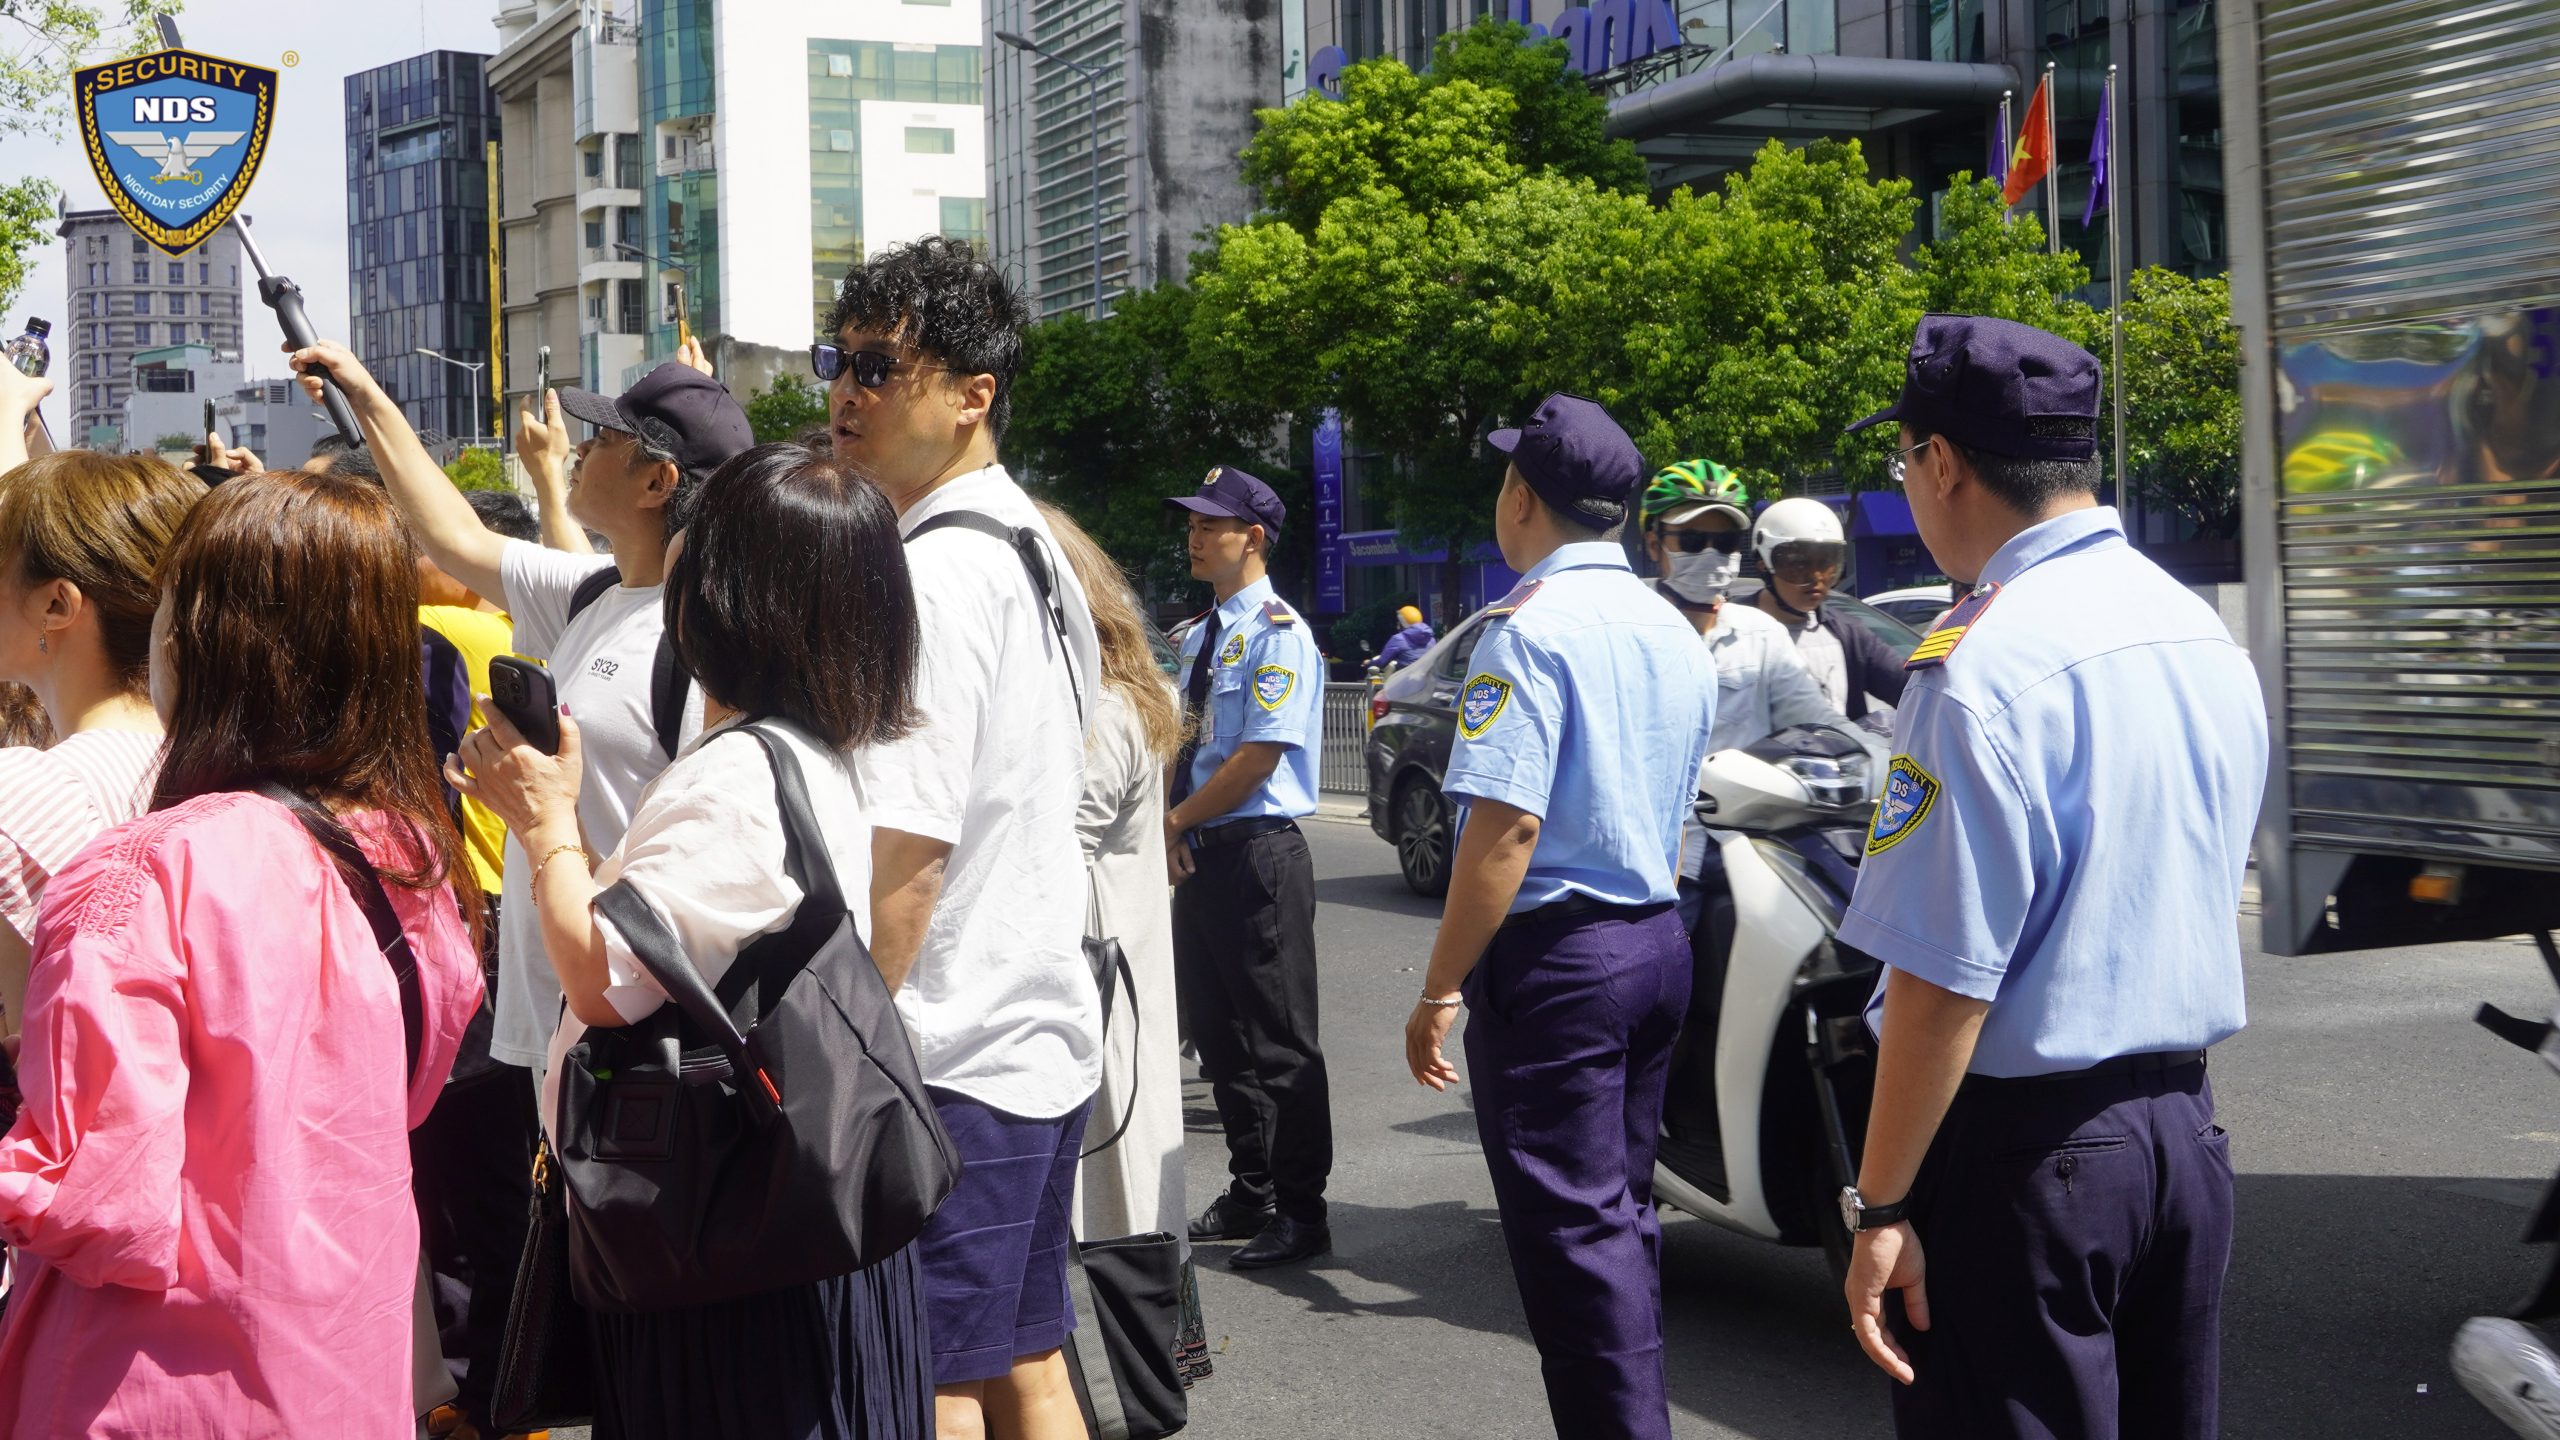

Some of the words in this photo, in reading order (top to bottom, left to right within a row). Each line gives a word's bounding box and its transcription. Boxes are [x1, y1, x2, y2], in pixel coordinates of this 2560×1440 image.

[1348, 540, 1399, 557] Sacombank
[591, 658, 619, 676] SY32
[1265, 675, 1280, 683] NDS
[1469, 676, 1501, 688] SECURITY
[1473, 689, 1489, 699] NDS
